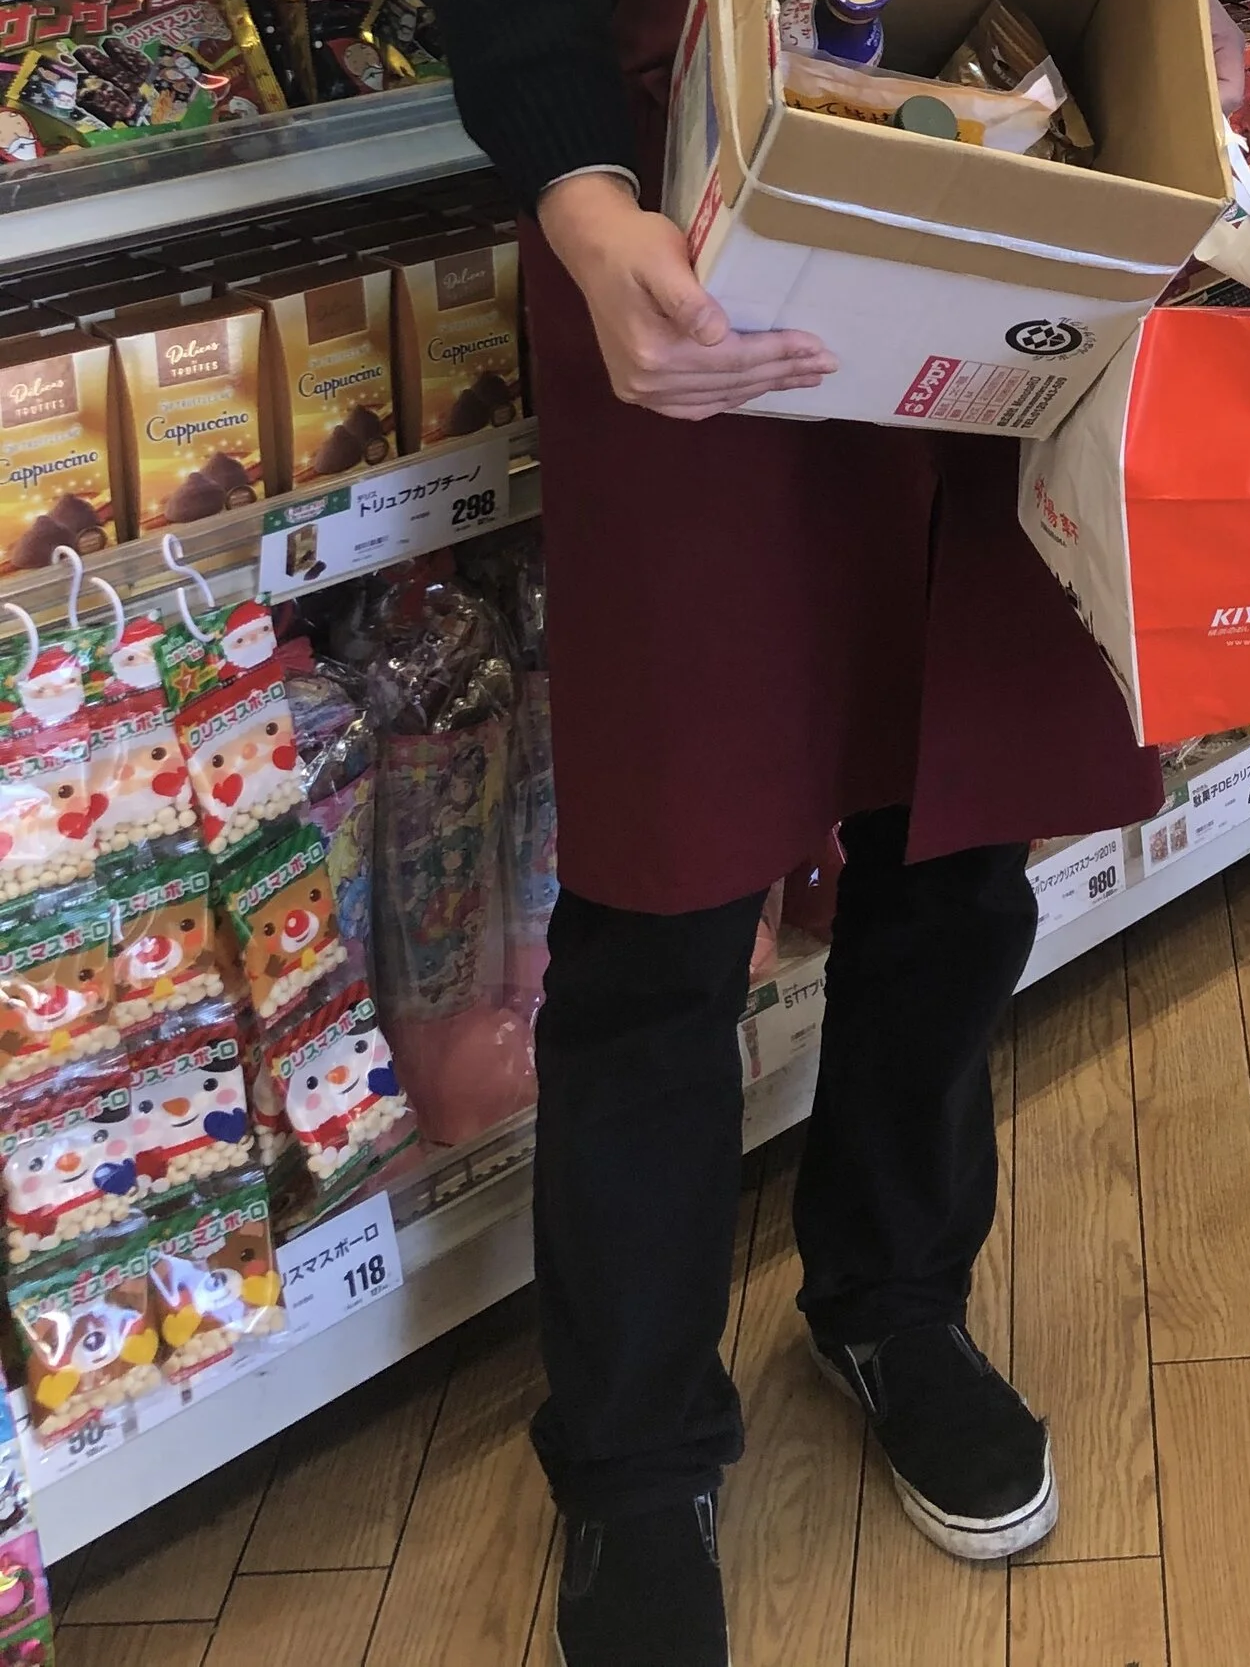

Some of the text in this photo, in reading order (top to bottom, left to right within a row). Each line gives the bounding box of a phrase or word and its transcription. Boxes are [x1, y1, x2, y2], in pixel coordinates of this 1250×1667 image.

[428, 333, 510, 365] Cappuccino
[298, 365, 383, 401] Cappuccino
[911, 359, 952, 402] モノタロウ
[146, 411, 249, 446] Cappuccino
[359, 465, 481, 518] トリュフカプチーノ
[452, 488, 496, 526] 298
[188, 680, 287, 748] クリスマスボーロ
[111, 871, 210, 921] スマスボーロ
[236, 841, 326, 915] クリスマスボーロ
[1088, 865, 1116, 899] 980
[280, 998, 376, 1078] クリスマスボーロ
[343, 1253, 386, 1299] 118
